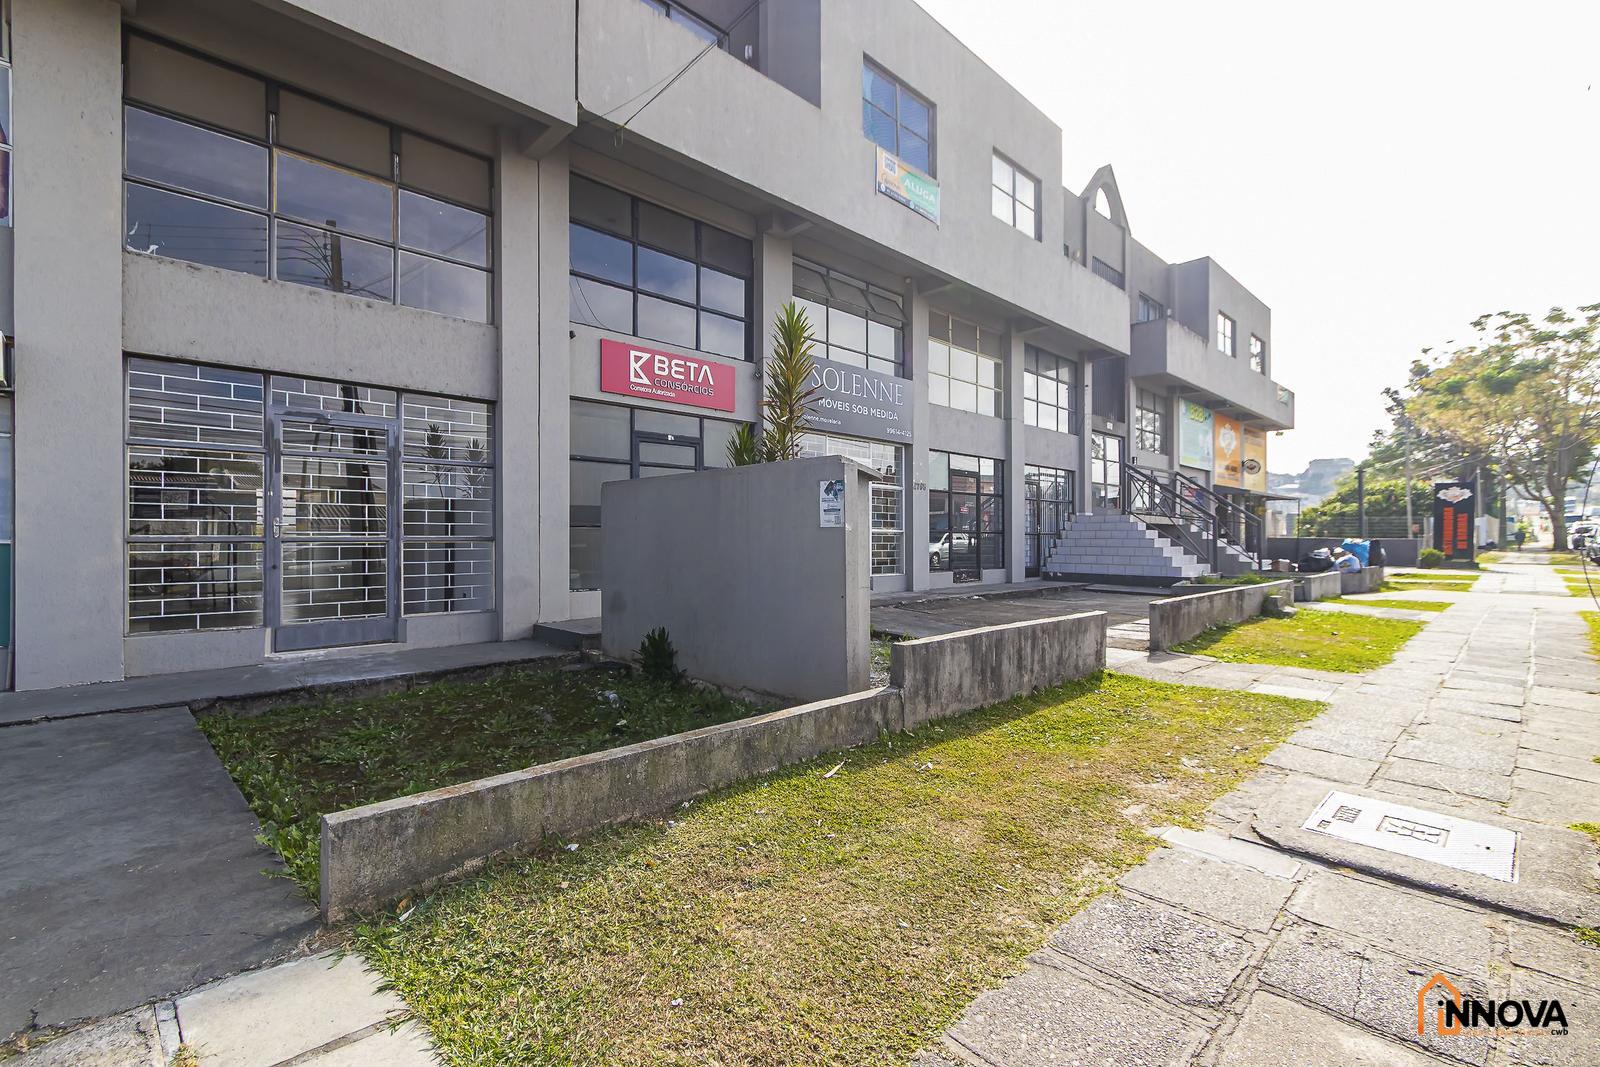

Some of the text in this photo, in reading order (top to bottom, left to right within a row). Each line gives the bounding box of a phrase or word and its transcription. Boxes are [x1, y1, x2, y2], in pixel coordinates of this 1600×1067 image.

[654, 354, 714, 386] BETA
[653, 377, 714, 396] CONSÓRCIOS
[811, 363, 904, 406] SOLENNE
[852, 403, 868, 415] SOB
[870, 407, 898, 421] MEDIDA
